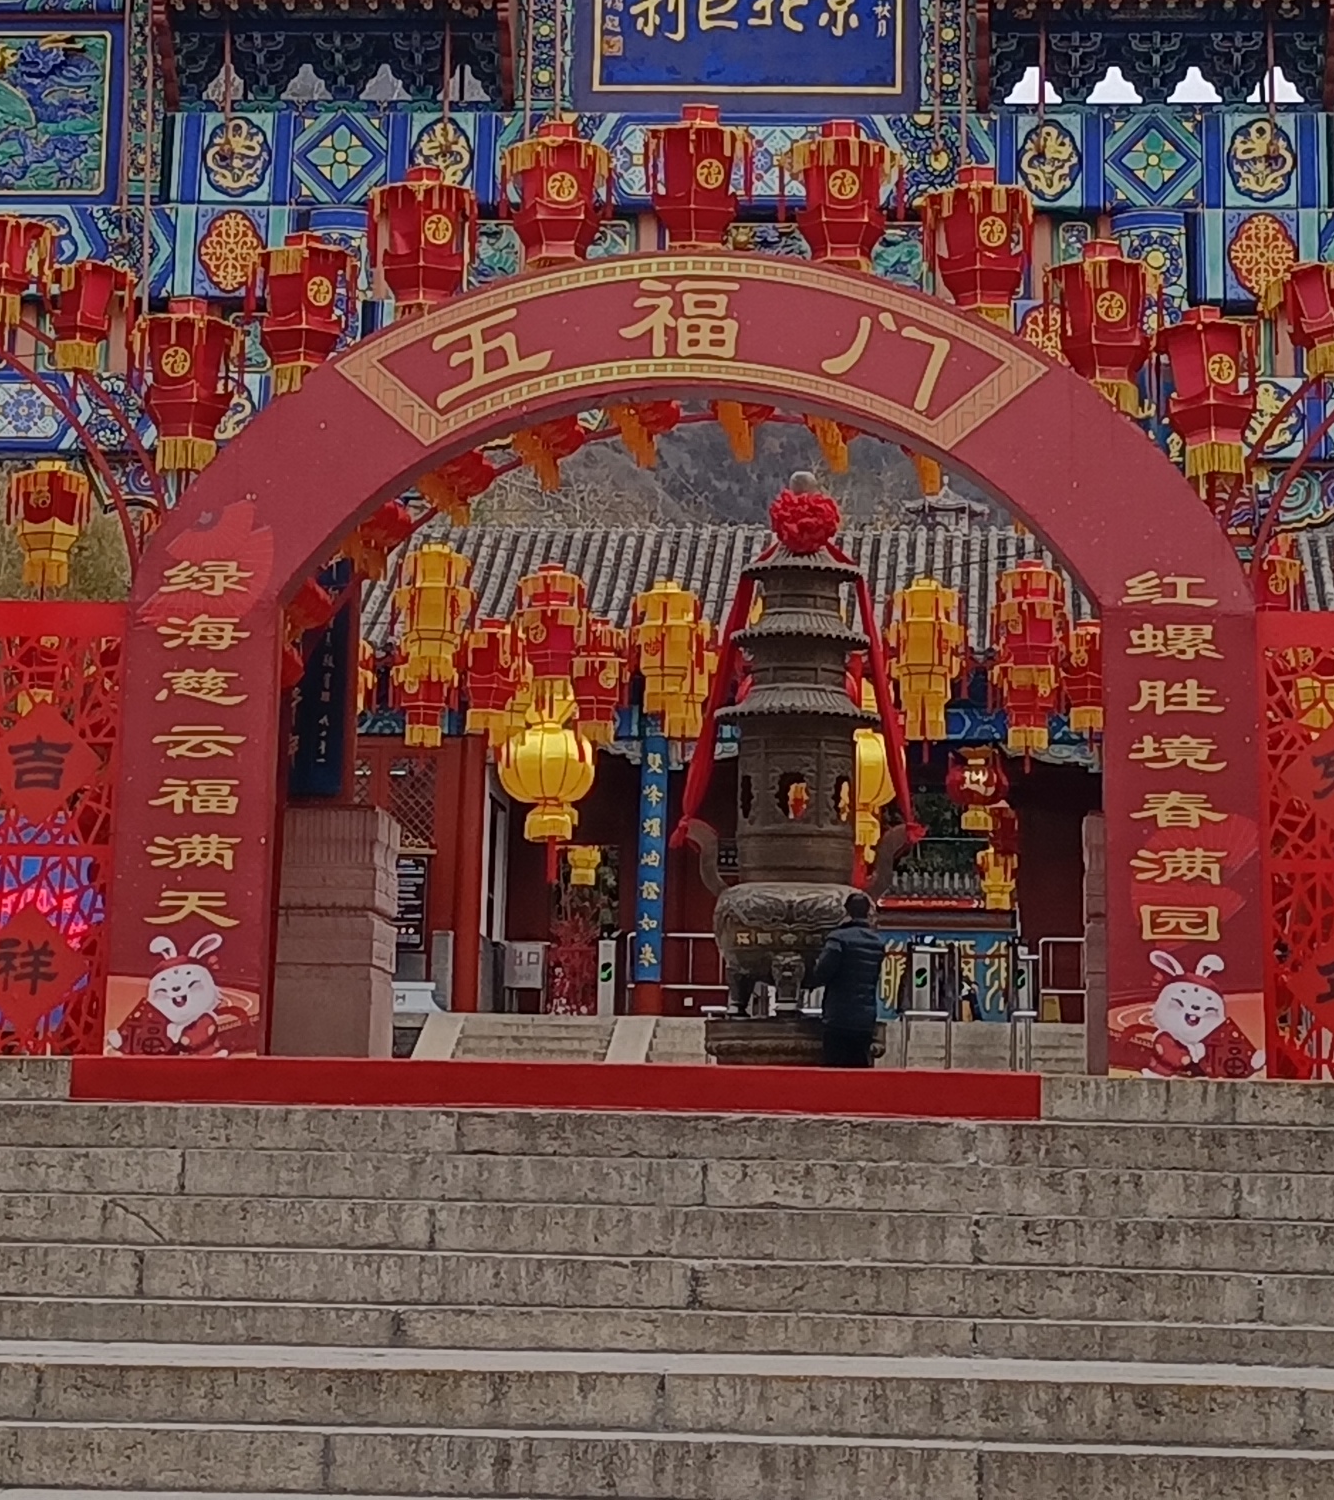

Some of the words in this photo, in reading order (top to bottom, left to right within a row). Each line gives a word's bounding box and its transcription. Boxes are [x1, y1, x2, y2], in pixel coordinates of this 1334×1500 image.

[432, 279, 950, 411] 五福门
[6, 737, 72, 791] 吉
[143, 560, 252, 928] 绿海慈云福满天
[1121, 570, 1228, 943] 红螺胜境春满园
